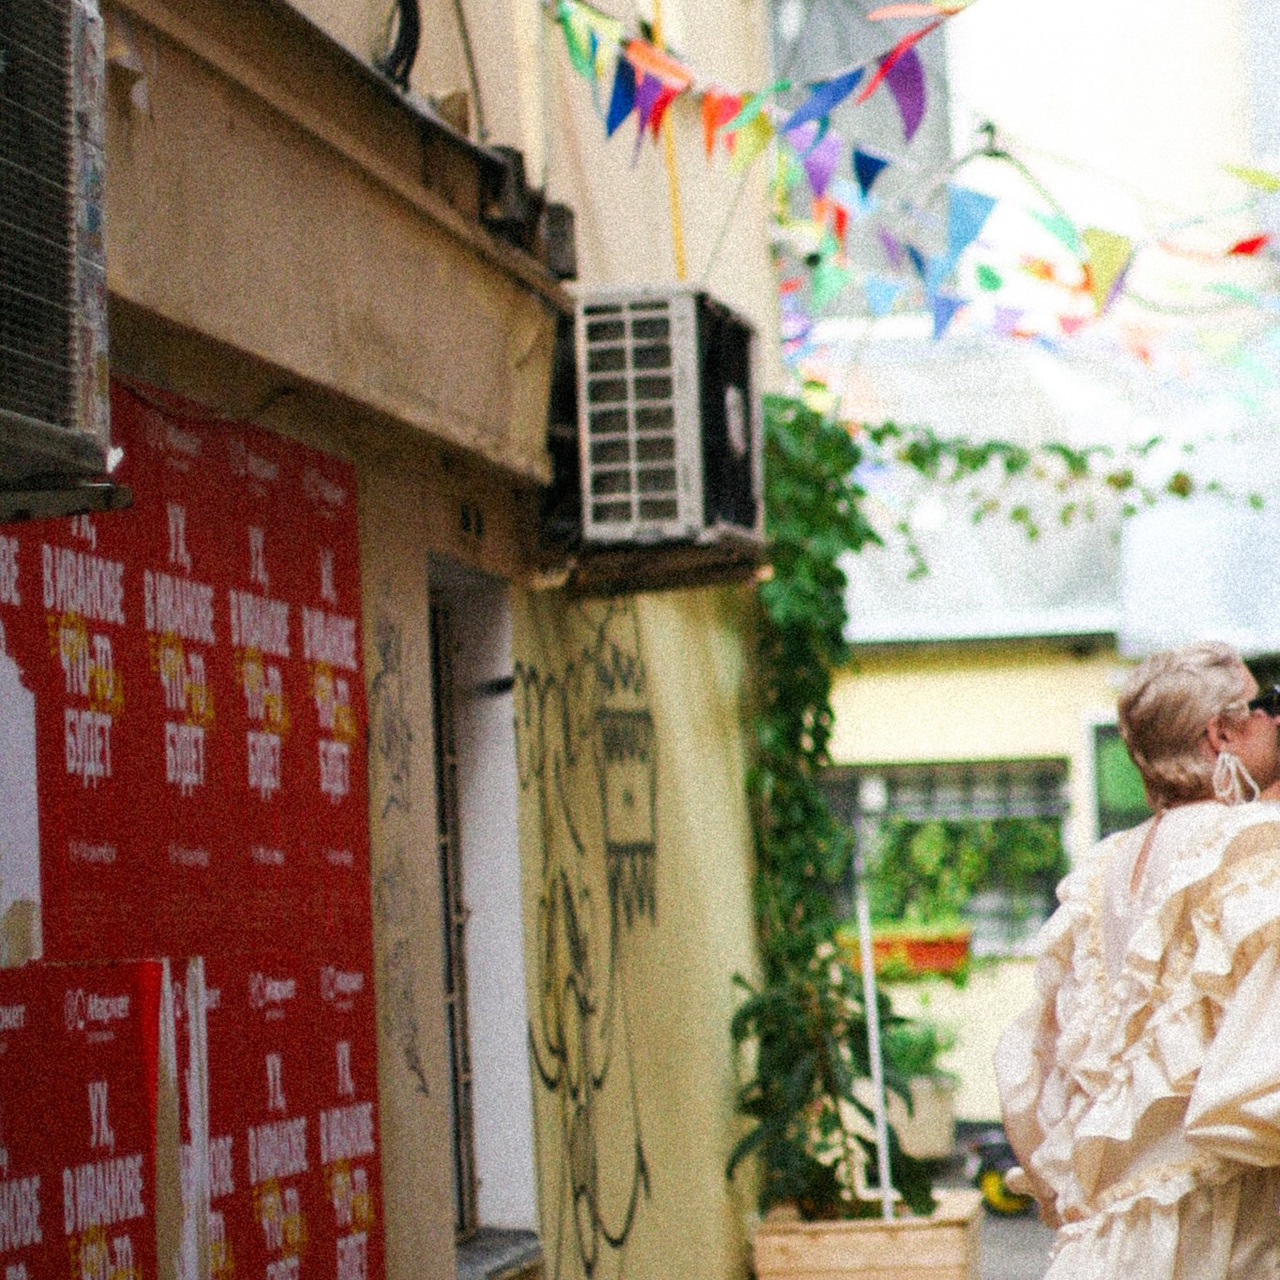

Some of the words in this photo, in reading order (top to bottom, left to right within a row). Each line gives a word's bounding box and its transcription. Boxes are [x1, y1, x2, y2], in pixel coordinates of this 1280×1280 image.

[54, 546, 126, 626] ИВАНОВЕ
[64, 707, 113, 789] БУДЕТ
[164, 721, 205, 797] БУДЕТ
[88, 1081, 115, 1154] УХ,
[76, 1154, 145, 1235] ИВАНОВЕ
